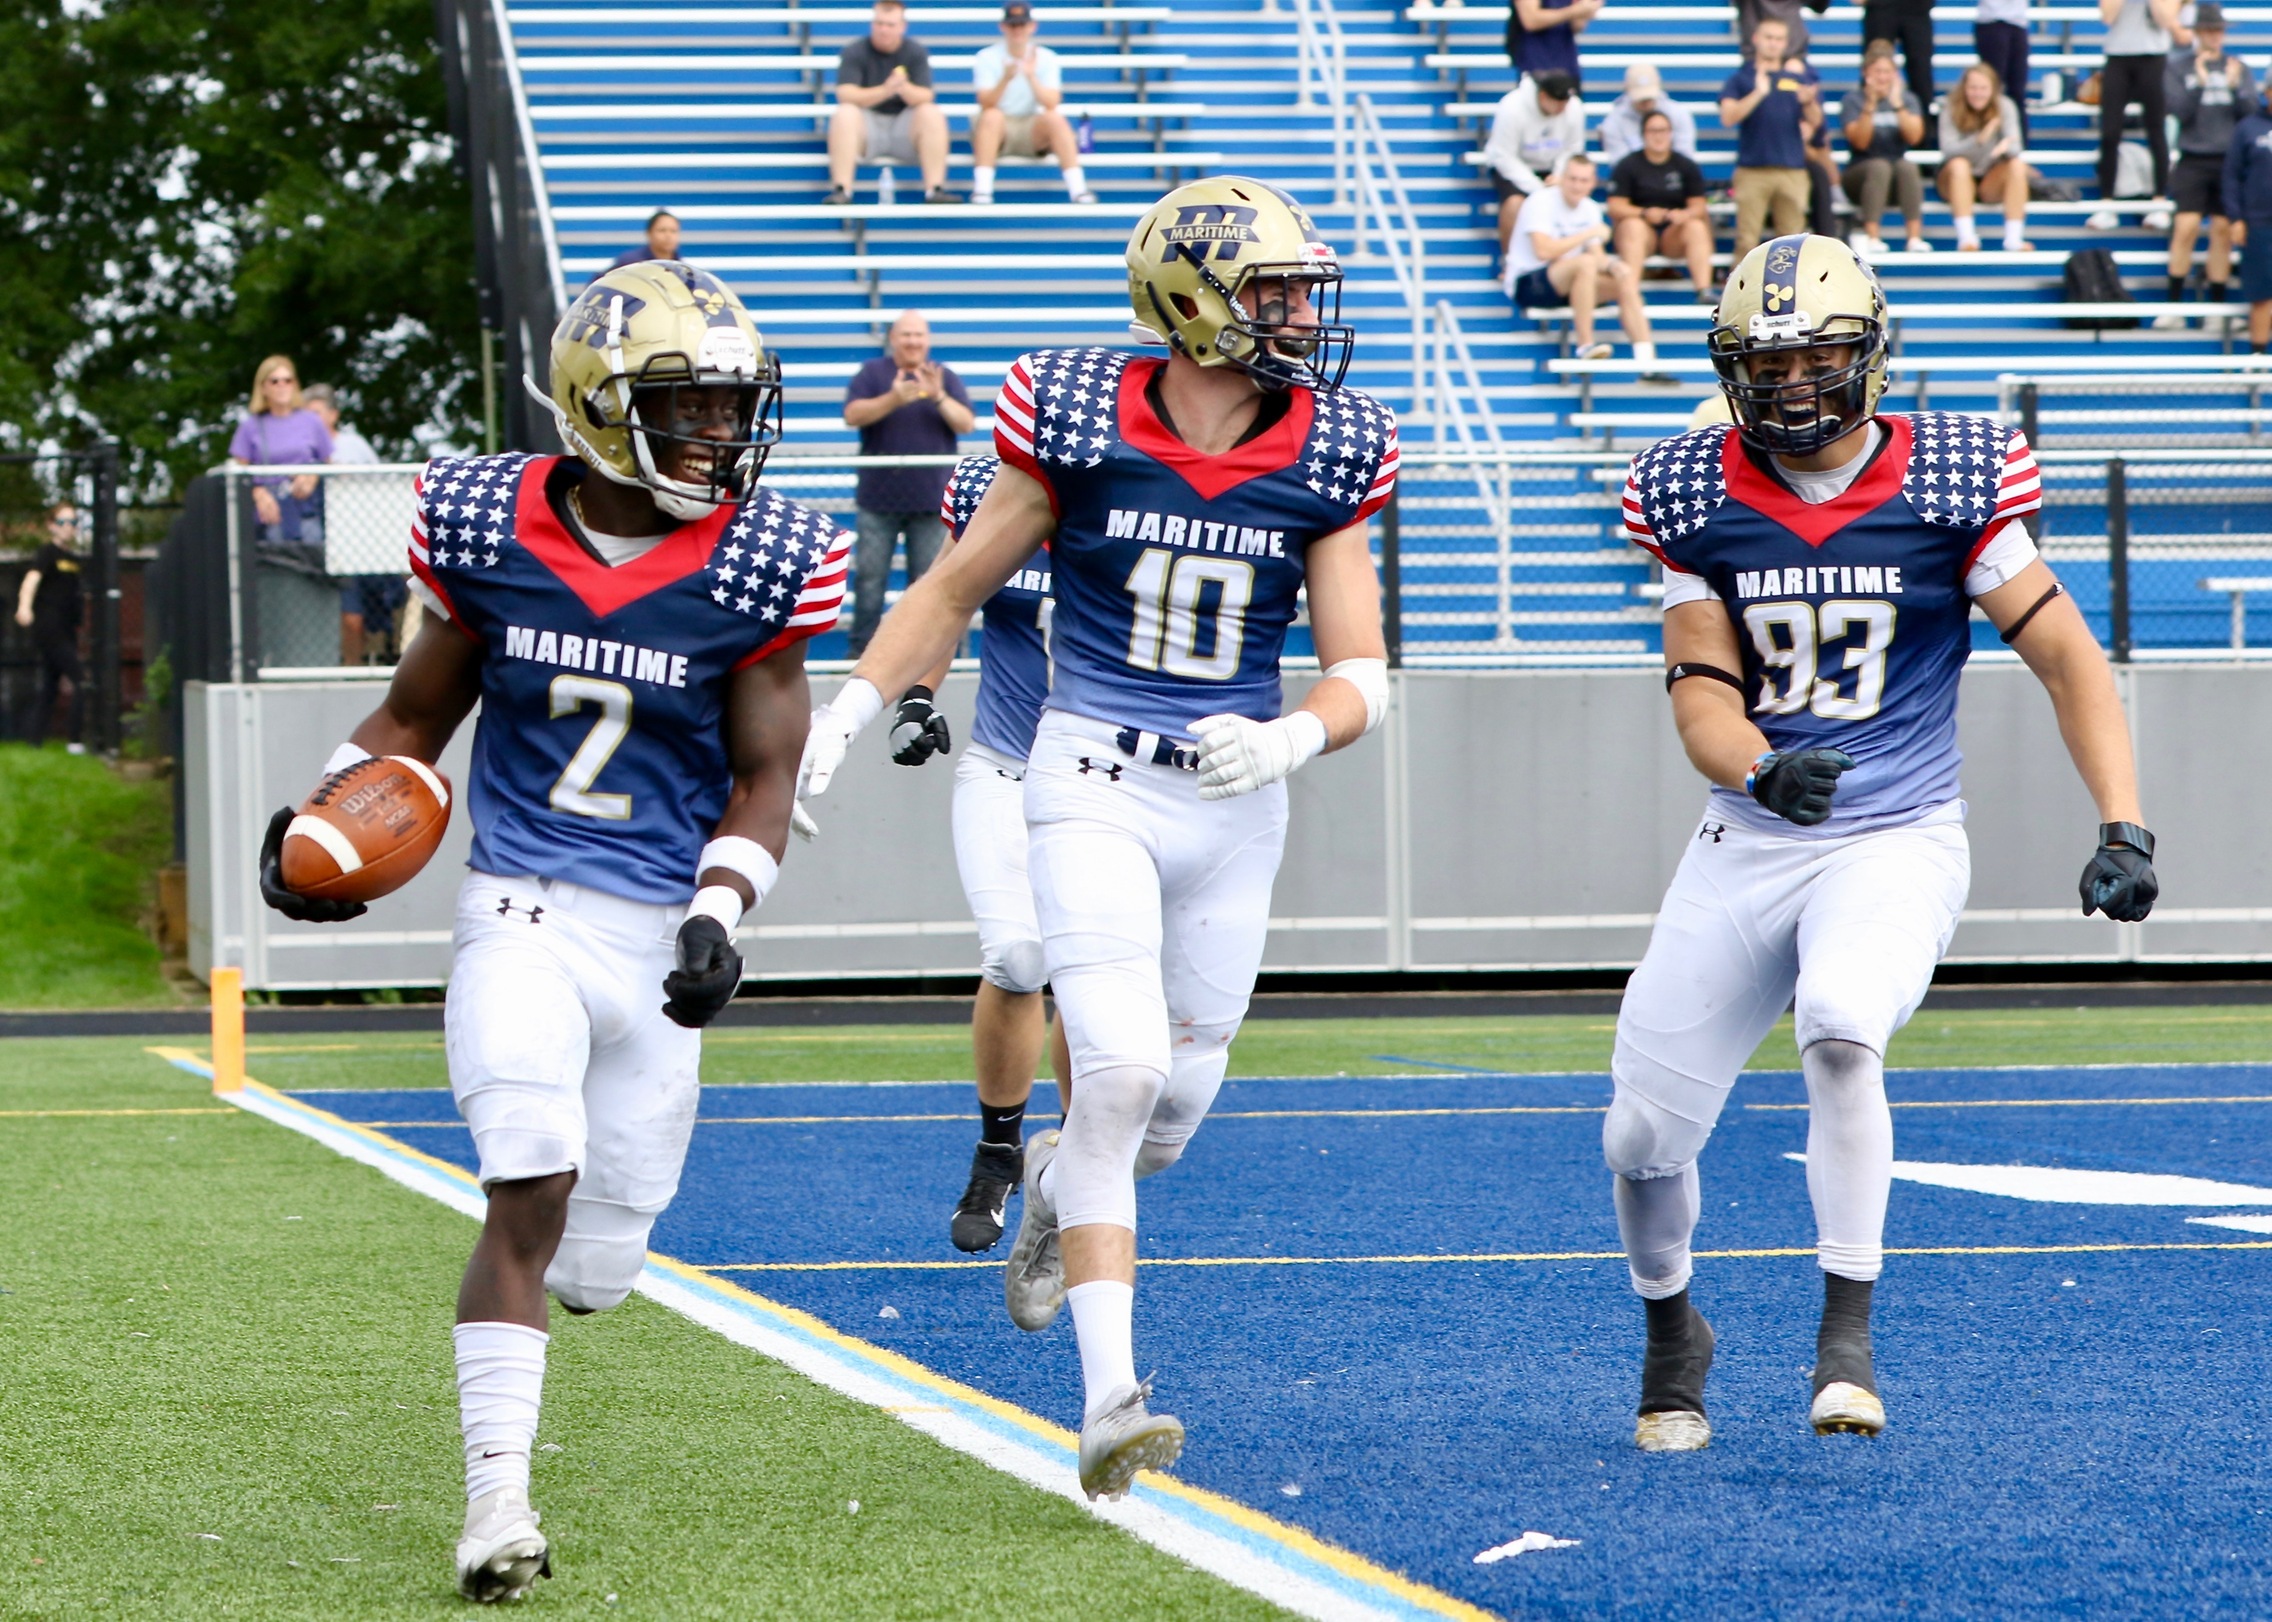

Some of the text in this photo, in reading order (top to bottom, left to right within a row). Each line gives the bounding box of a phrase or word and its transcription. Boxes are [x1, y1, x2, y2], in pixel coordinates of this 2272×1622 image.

[1170, 226, 1248, 241] MARITIME
[1105, 509, 1286, 558] MARITIME
[1735, 567, 1904, 598] MARITIME
[1124, 547, 1256, 680] 10
[505, 626, 689, 688] MARITIME
[1743, 600, 1897, 720] 93
[549, 674, 633, 820] 2
[339, 772, 401, 814] Wilson
